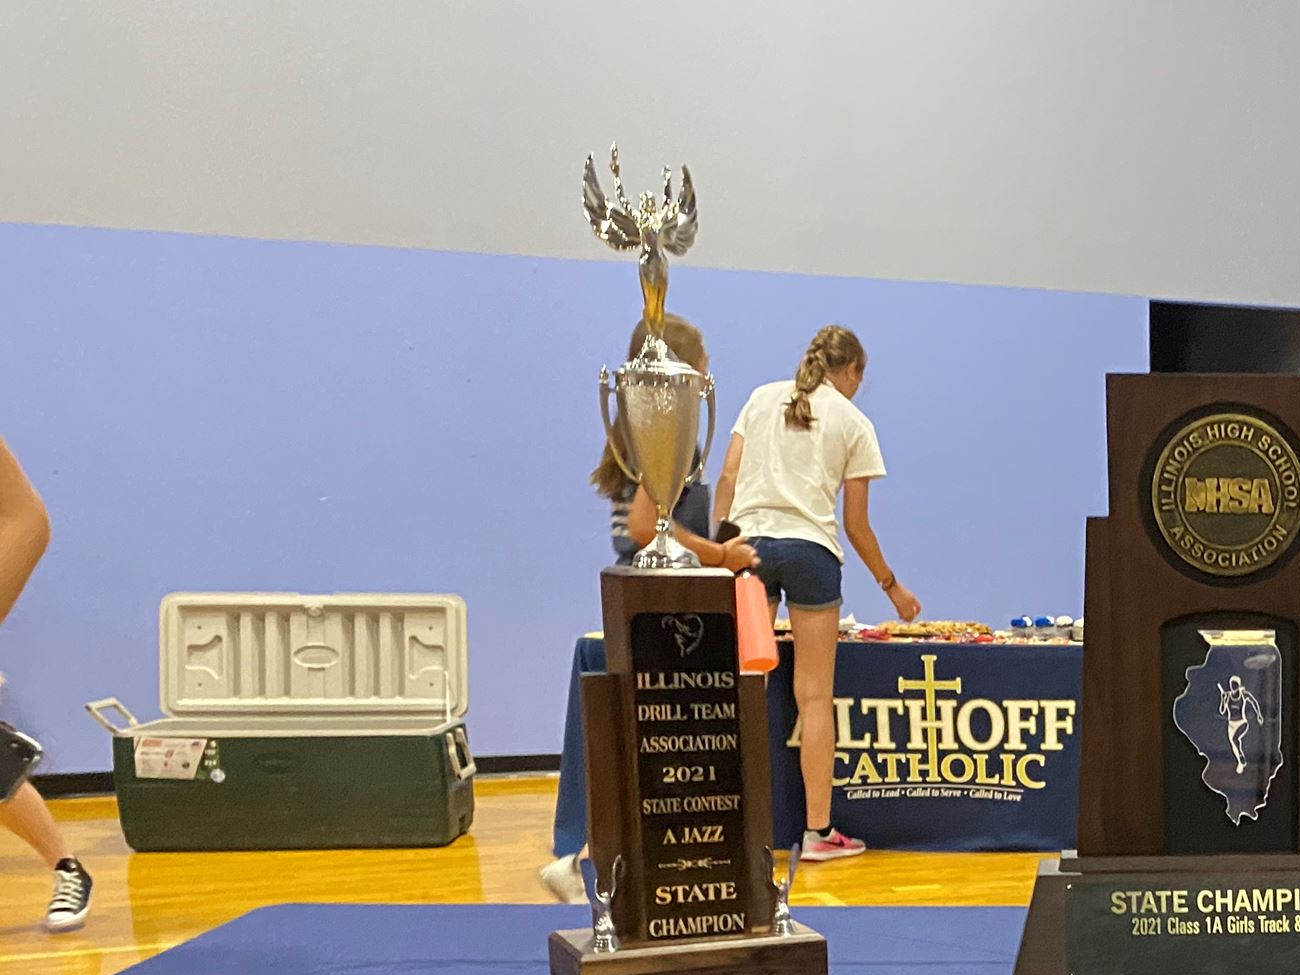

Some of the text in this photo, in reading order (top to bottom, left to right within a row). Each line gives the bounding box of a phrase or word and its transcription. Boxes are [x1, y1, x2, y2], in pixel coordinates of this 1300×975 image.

[1161, 423, 1298, 512] ILLINOIS HIGH SCHOOL
[1169, 523, 1288, 568] ASSOCIATION
[636, 671, 735, 690] ILLINOIS
[638, 702, 736, 721] DRILL TEAM
[640, 734, 738, 753] ASSOCIATION
[662, 766, 717, 783] 2021
[832, 752, 1046, 789] CATHOLIC
[642, 795, 741, 815] STATE CONTEST
[847, 790, 871, 800] Called
[881, 789, 900, 798] Lead
[906, 788, 930, 798] Called
[940, 788, 961, 798] Serve
[969, 789, 993, 799] Called
[1003, 791, 1022, 802] Love
[662, 825, 724, 845] A JAZZ
[655, 881, 737, 906] STATE
[1110, 890, 1189, 914] STATE
[649, 912, 746, 938] CHAMPION
[1131, 917, 1162, 935] 2021
[1167, 916, 1200, 935] Class
[1205, 916, 1223, 934] 1A
[1227, 915, 1255, 934] Girls
[1258, 914, 1290, 933] Track
